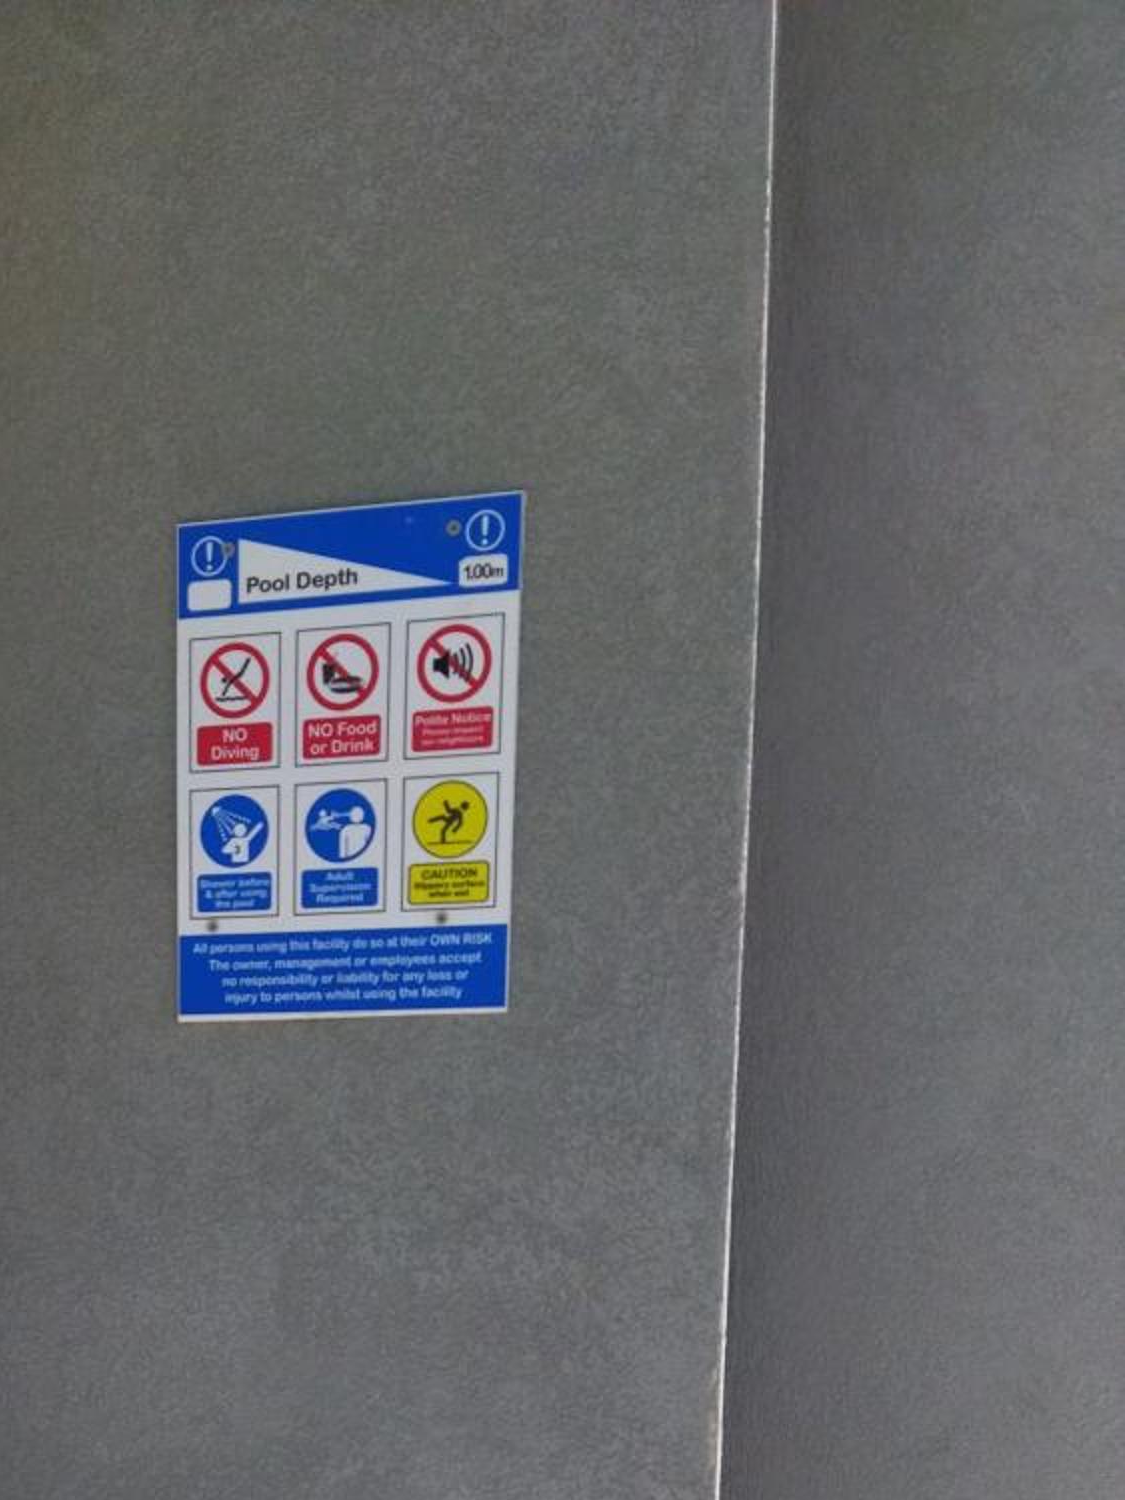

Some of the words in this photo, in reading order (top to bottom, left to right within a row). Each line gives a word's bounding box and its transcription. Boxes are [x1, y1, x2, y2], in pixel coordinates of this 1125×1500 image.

[246, 576, 290, 594] Pool
[296, 568, 358, 592] Depth
[223, 728, 248, 743] NO
[308, 723, 332, 738] NO
[337, 720, 377, 736] Food
[210, 745, 260, 761] Diving
[310, 742, 328, 755] or
[331, 738, 374, 753] Drink
[421, 867, 478, 879] CAUTION
[193, 943, 208, 953] All
[289, 939, 310, 950] this
[313, 938, 350, 952] facility
[353, 937, 368, 948] do
[370, 938, 384, 948] so
[387, 936, 398, 947] at
[400, 935, 426, 946] their
[430, 933, 461, 946] OWN
[463, 932, 492, 944] RISK
[209, 959, 230, 971] The
[232, 960, 272, 972] owner,
[275, 957, 351, 970] management
[354, 955, 368, 967] or
[370, 954, 436, 968] employees
[439, 952, 483, 965] accept
[222, 976, 237, 986] no
[239, 973, 319, 988] responsibility
[321, 974, 334, 984] or
[336, 971, 379, 985] liability
[382, 970, 399, 982] for
[402, 971, 425, 984] any
[426, 969, 453, 981] loss
[455, 969, 470, 980] or
[225, 992, 257, 1005] injury
[260, 991, 272, 1002] to
[275, 991, 323, 1004] persons
[326, 988, 360, 1000] whilst
[362, 988, 397, 1001] using
[399, 986, 419, 998] the
[421, 985, 463, 1000] facility
